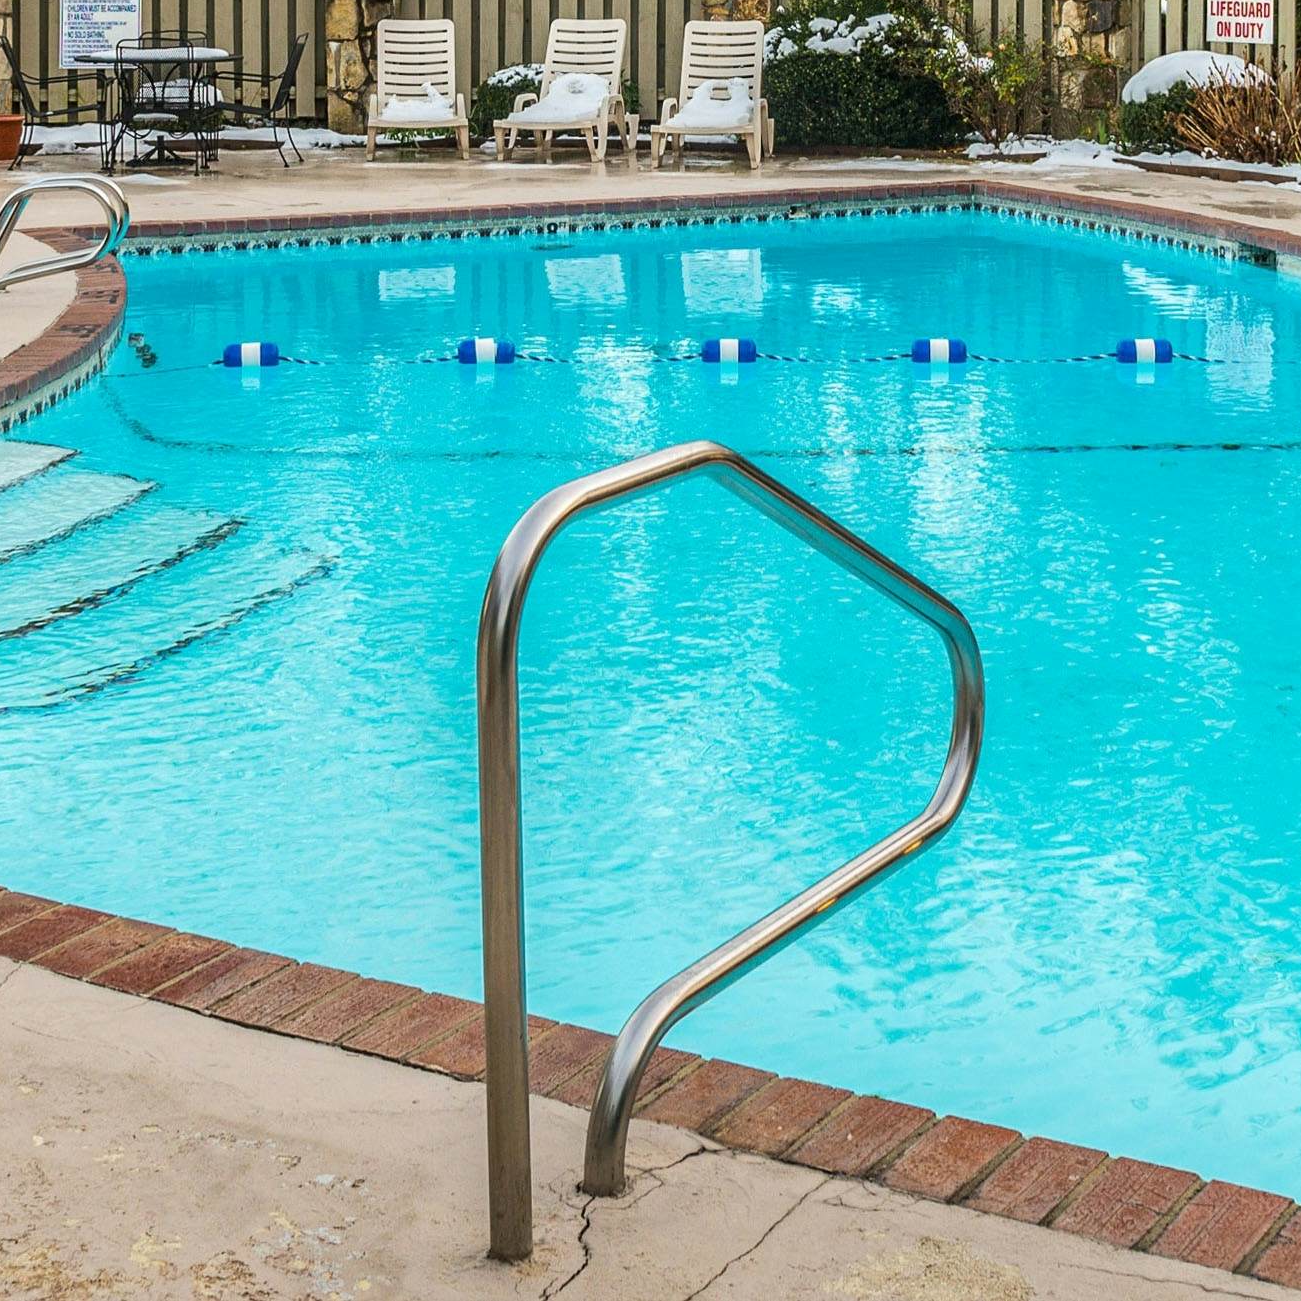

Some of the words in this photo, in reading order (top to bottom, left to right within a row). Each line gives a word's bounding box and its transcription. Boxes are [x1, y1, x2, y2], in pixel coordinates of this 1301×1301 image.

[67, 4, 88, 12] CHILDREN
[89, 4, 100, 12] MUST
[1210, 0, 1270, 18] LIFEGUARD
[1216, 21, 1231, 37] ON
[1235, 22, 1264, 39] DUTY
